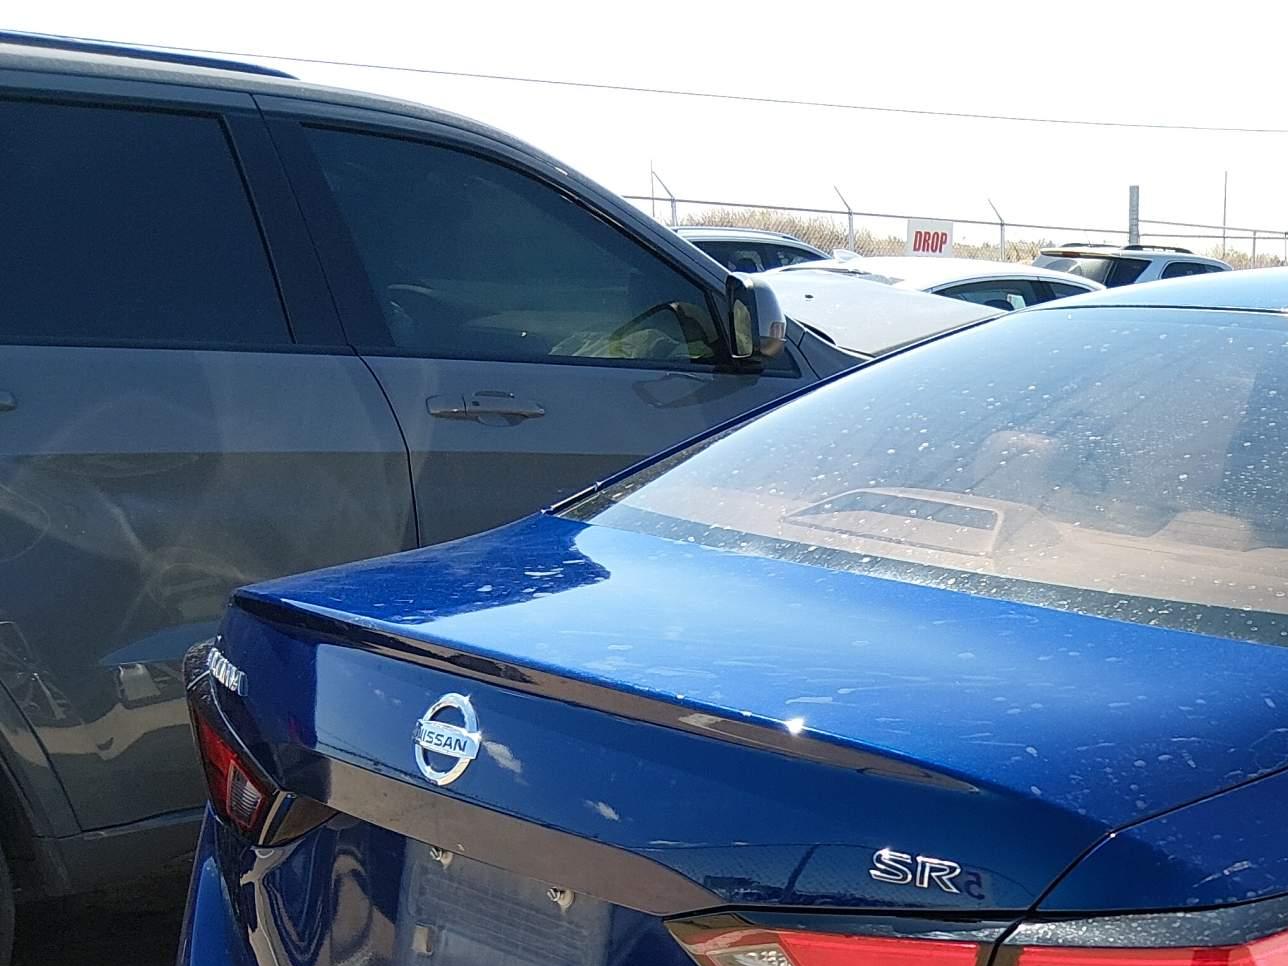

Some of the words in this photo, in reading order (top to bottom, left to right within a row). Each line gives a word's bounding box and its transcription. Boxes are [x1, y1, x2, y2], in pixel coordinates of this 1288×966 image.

[912, 230, 948, 253] DROP
[417, 727, 468, 752] NISSAN
[869, 848, 961, 894] SR
